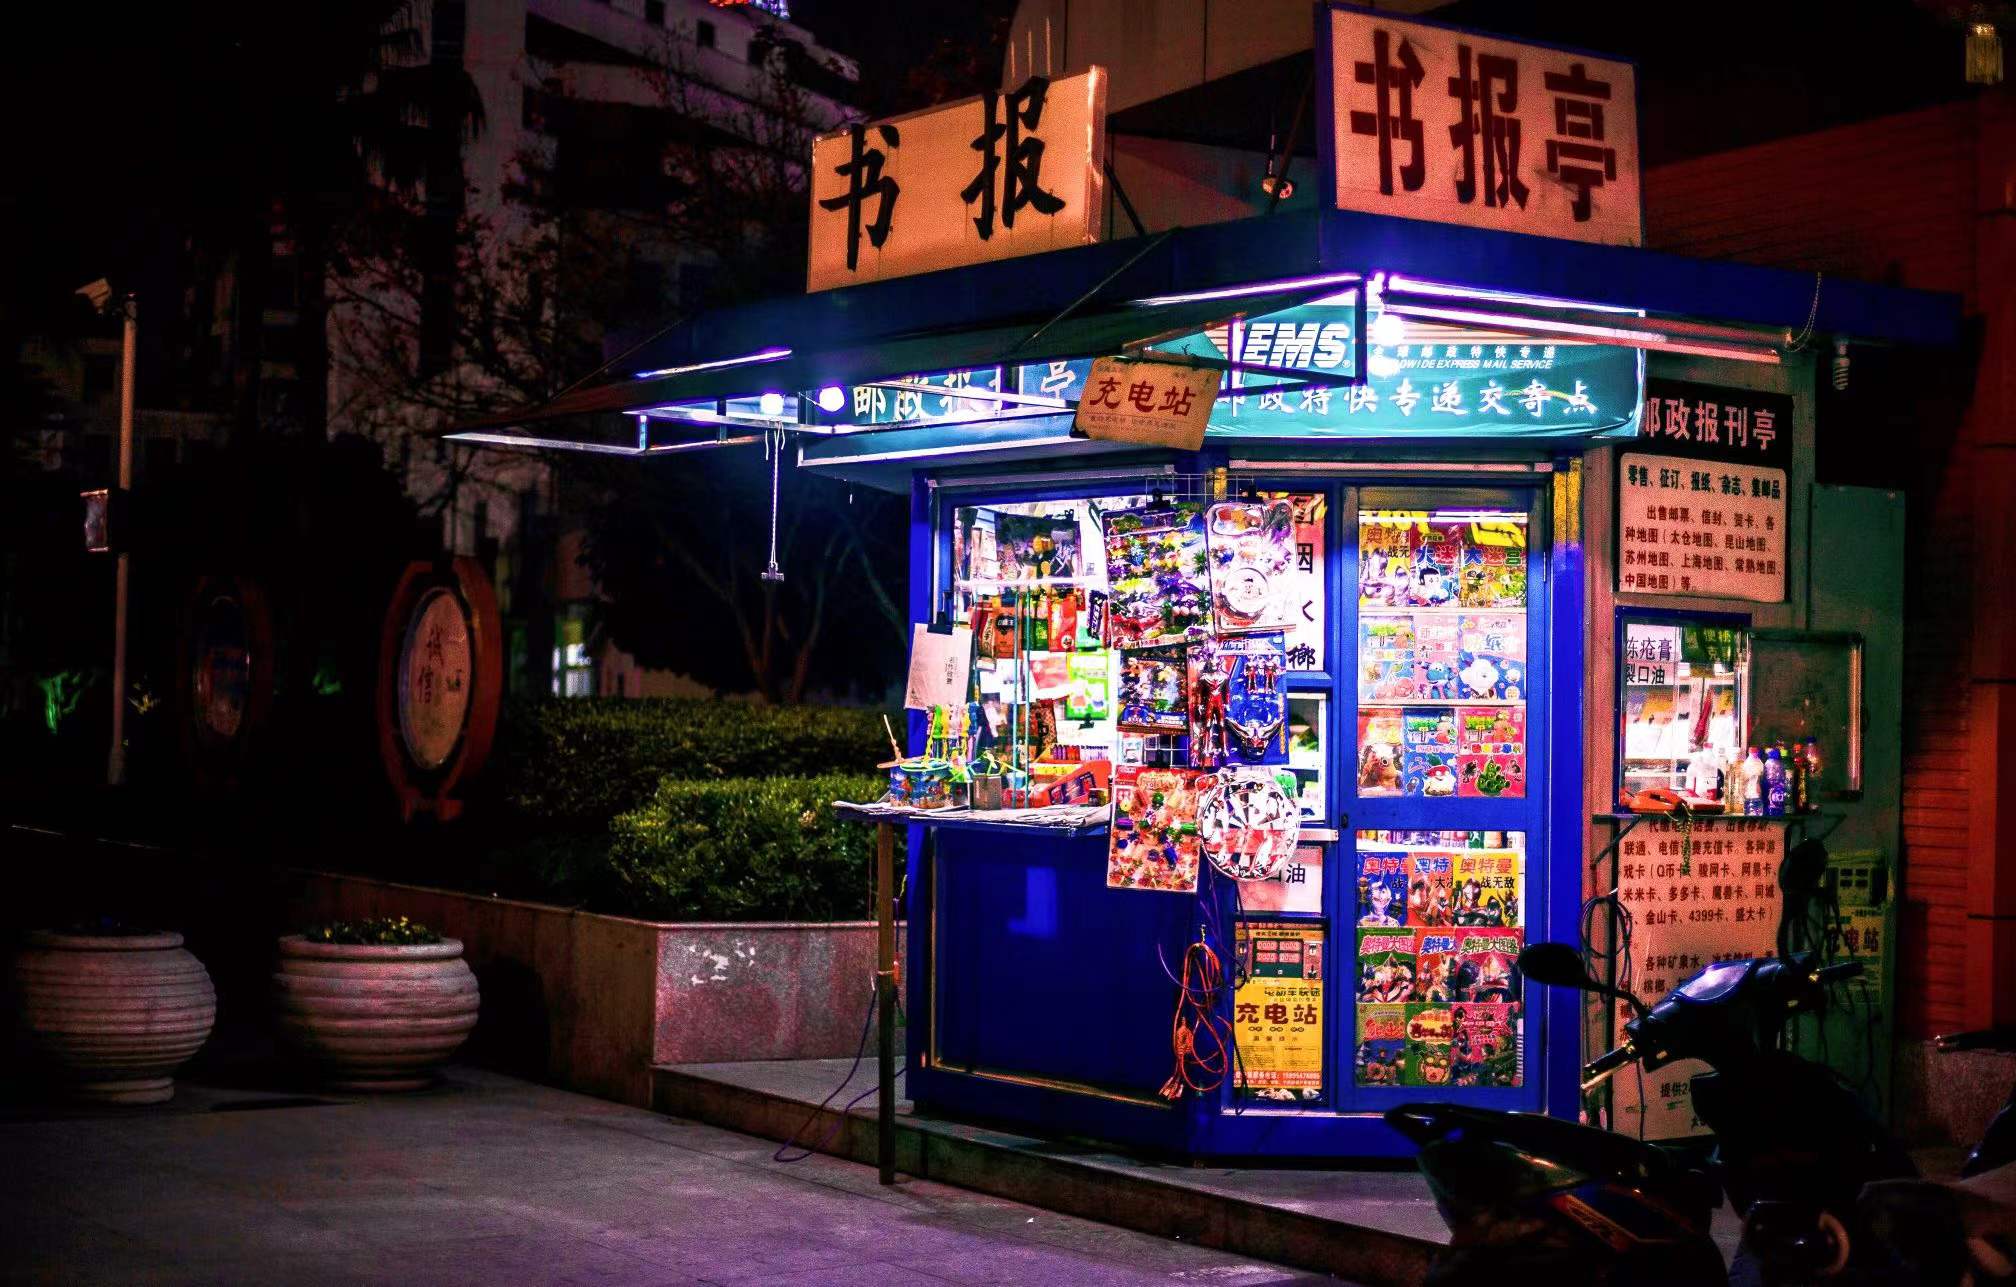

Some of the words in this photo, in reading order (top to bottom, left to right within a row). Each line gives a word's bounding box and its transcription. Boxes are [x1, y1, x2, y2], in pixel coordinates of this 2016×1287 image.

[1350, 27, 1618, 223] 书报亭
[818, 75, 1067, 272] 书报
[1242, 322, 1350, 369] EMS
[1482, 359, 1508, 369] MAIL
[1510, 359, 1554, 369] SERVICE
[1089, 376, 1197, 417] 充电站
[1645, 397, 1777, 451] 邮政报刊亭
[1415, 856, 1451, 874] 奥特
[1460, 857, 1513, 874] 奥特曼
[1235, 1002, 1318, 1025] 充电站
